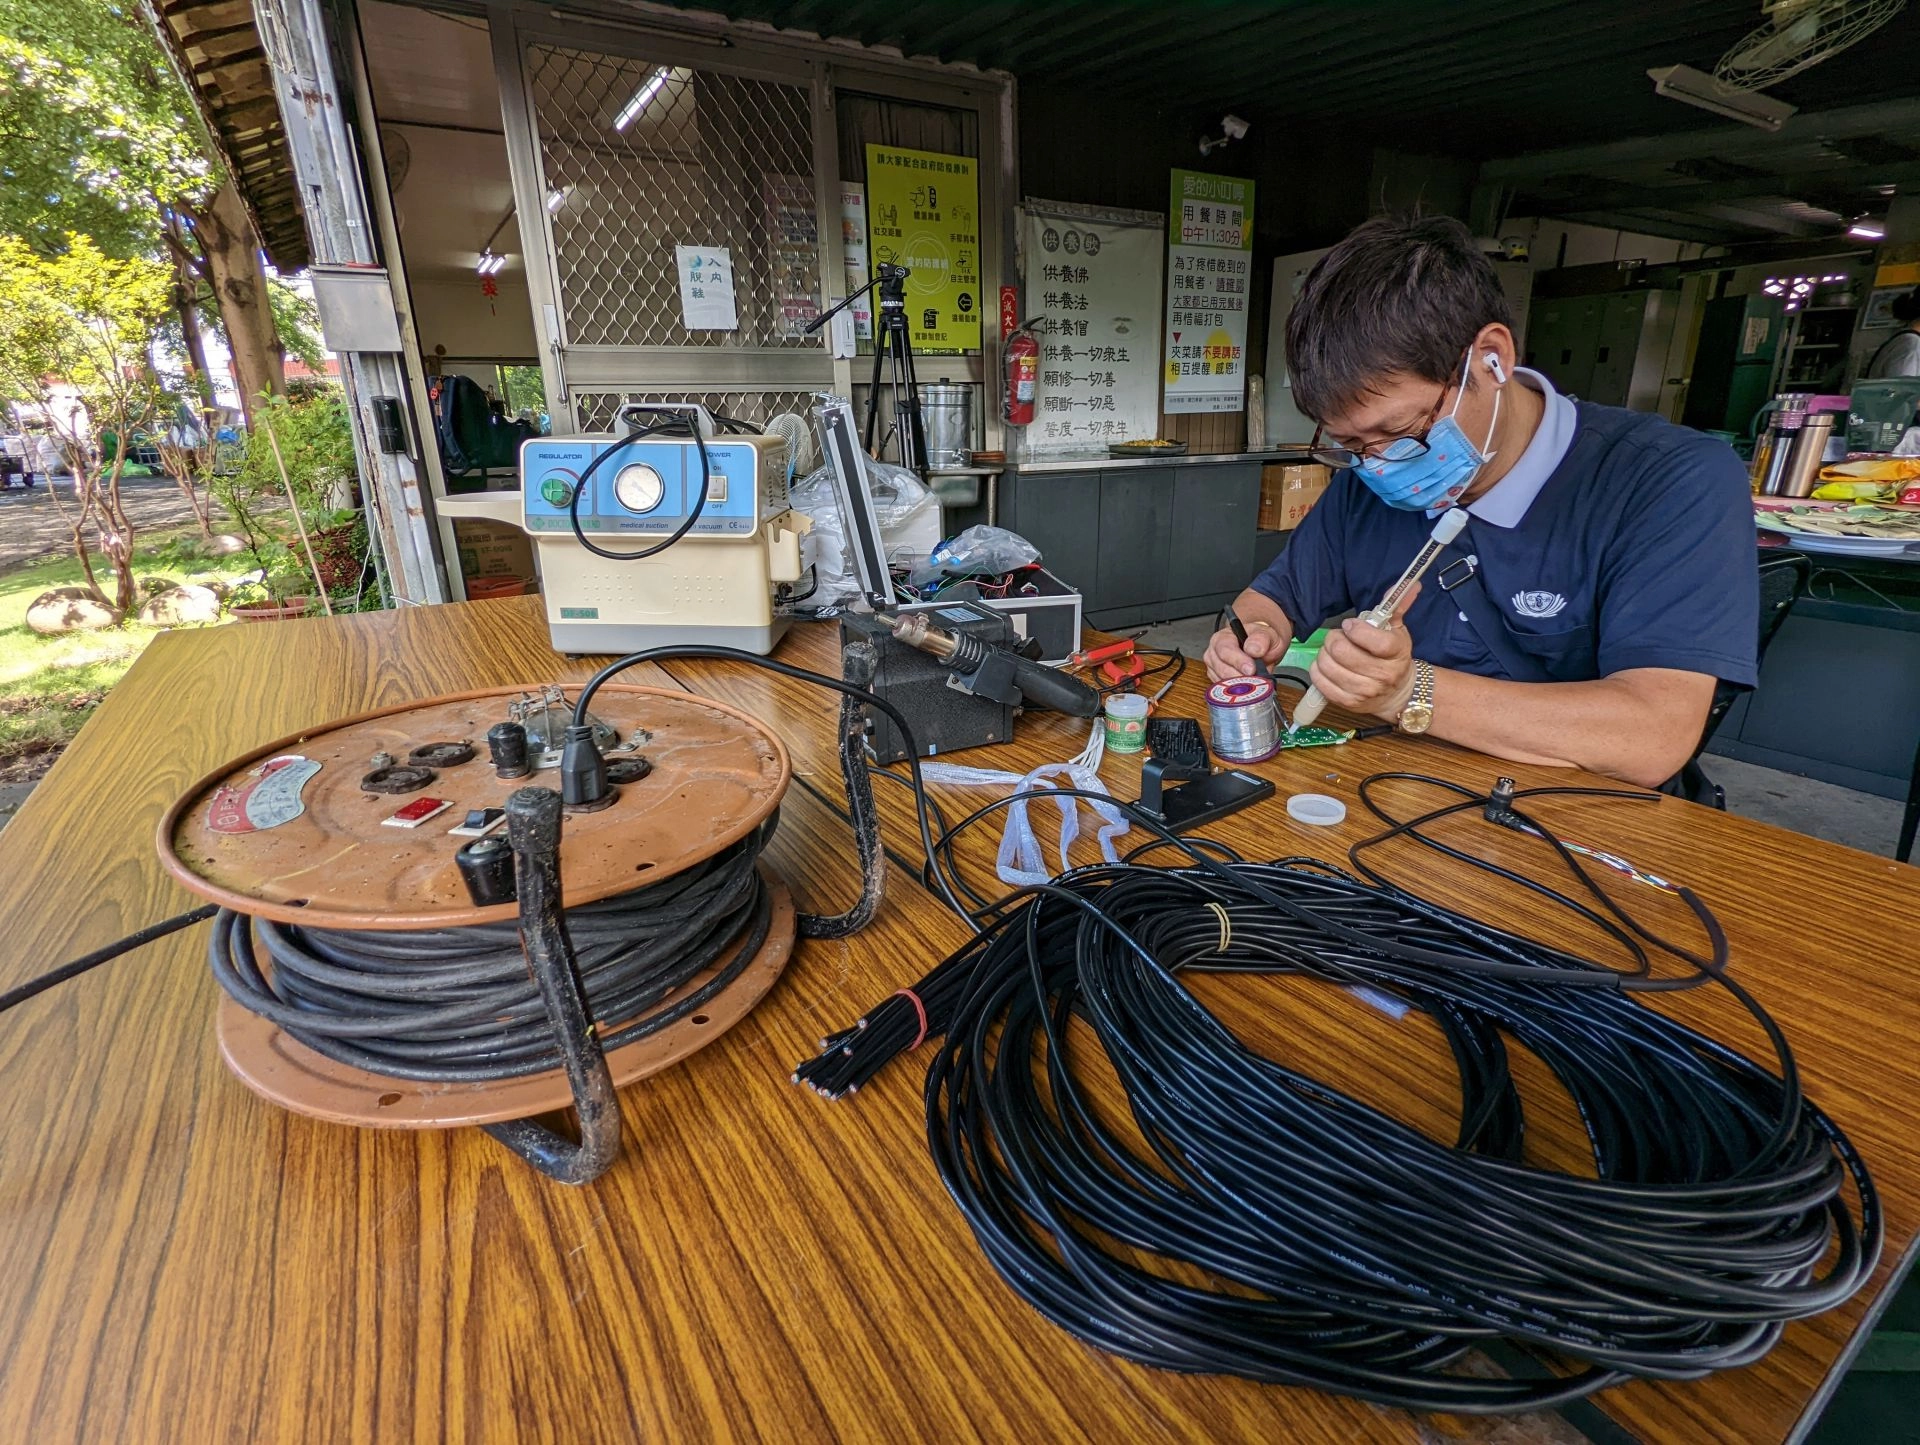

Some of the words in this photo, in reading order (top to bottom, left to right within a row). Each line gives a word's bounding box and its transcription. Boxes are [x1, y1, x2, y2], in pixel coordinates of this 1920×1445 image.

[1183, 205, 1242, 227] 用餐時間
[873, 227, 903, 238] 社交距離
[708, 257, 723, 284] 入內
[1043, 264, 1089, 284] 供養佛
[1043, 290, 1089, 311] 供養法
[1043, 317, 1089, 336] 供養僧
[1172, 311, 1224, 327] 再惜福打包
[1171, 345, 1241, 360] 夾菜請不要講話
[1171, 362, 1211, 376] 相互提醒
[1043, 370, 1116, 387] 願修一切善
[1043, 395, 1116, 412] 願斷一切惡
[1289, 504, 1313, 519] 台灣
[548, 519, 572, 529] DOCTO
[728, 521, 738, 529] CE
[1407, 1283, 1430, 1295] AWM
